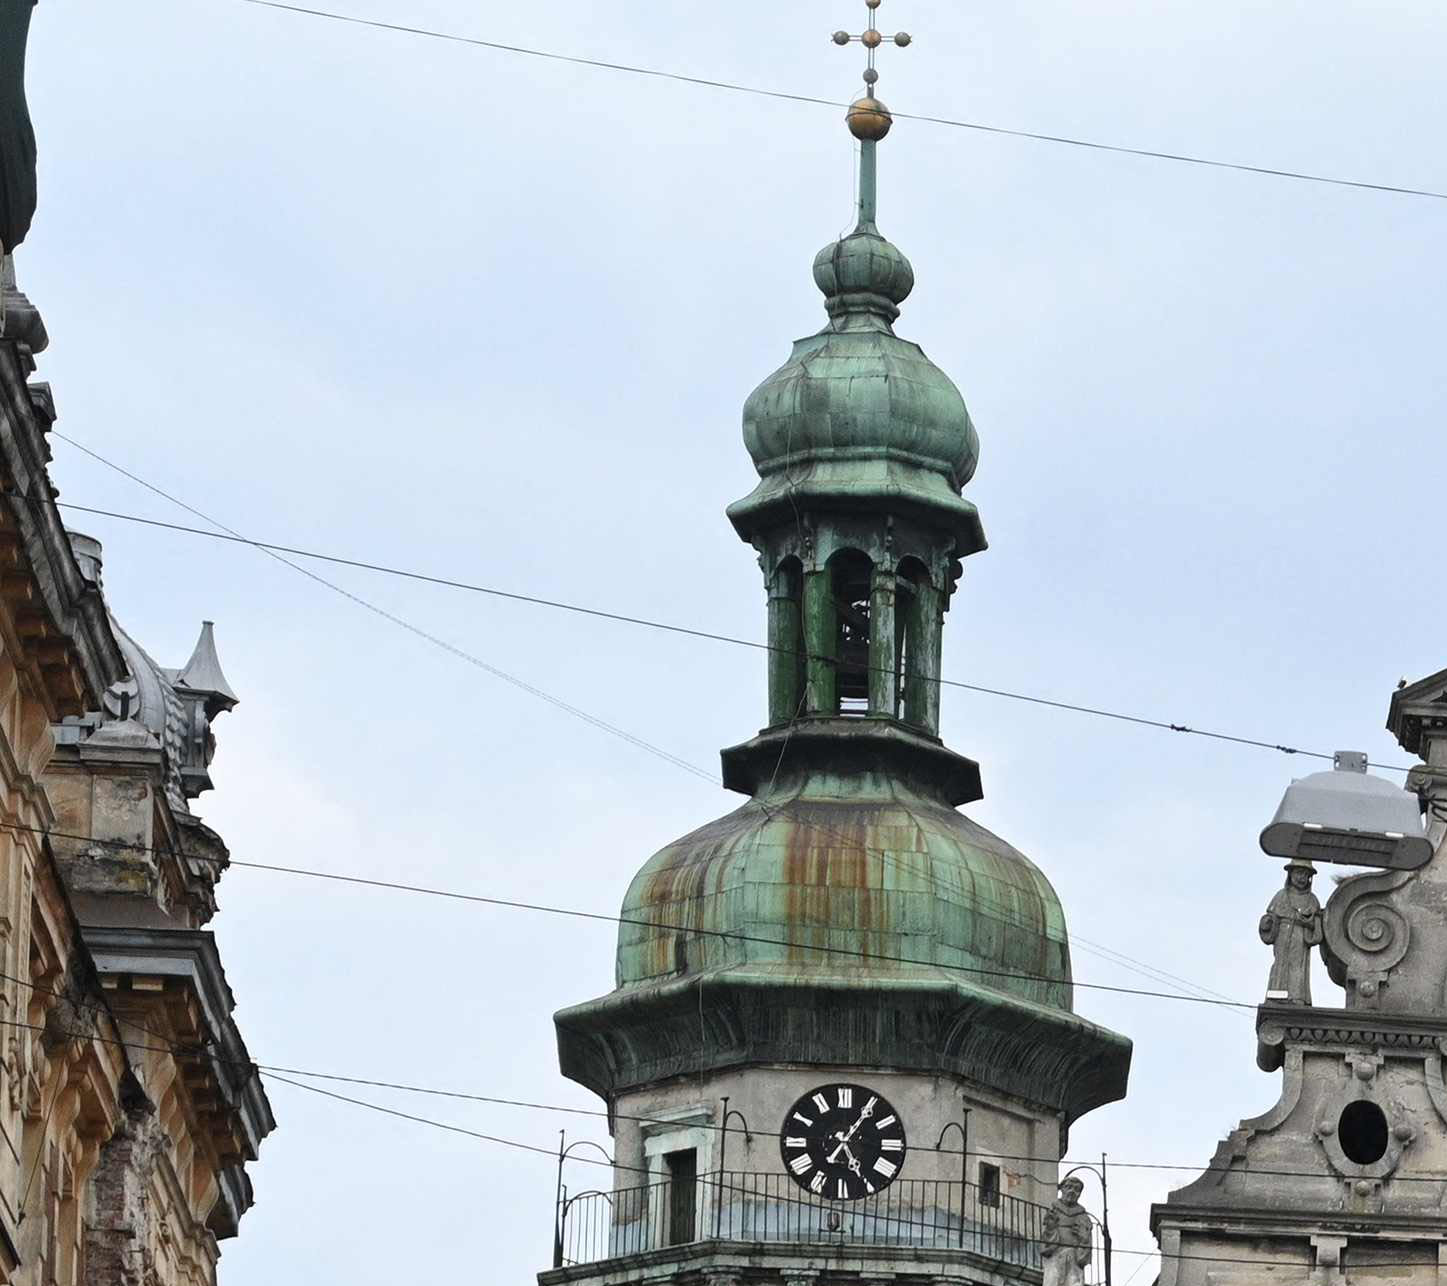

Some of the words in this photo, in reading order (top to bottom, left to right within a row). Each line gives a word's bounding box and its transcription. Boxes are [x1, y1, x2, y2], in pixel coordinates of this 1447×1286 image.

[812, 1092, 830, 1114] XI
[838, 1088, 852, 1108] XII
[793, 1112, 813, 1127] X
